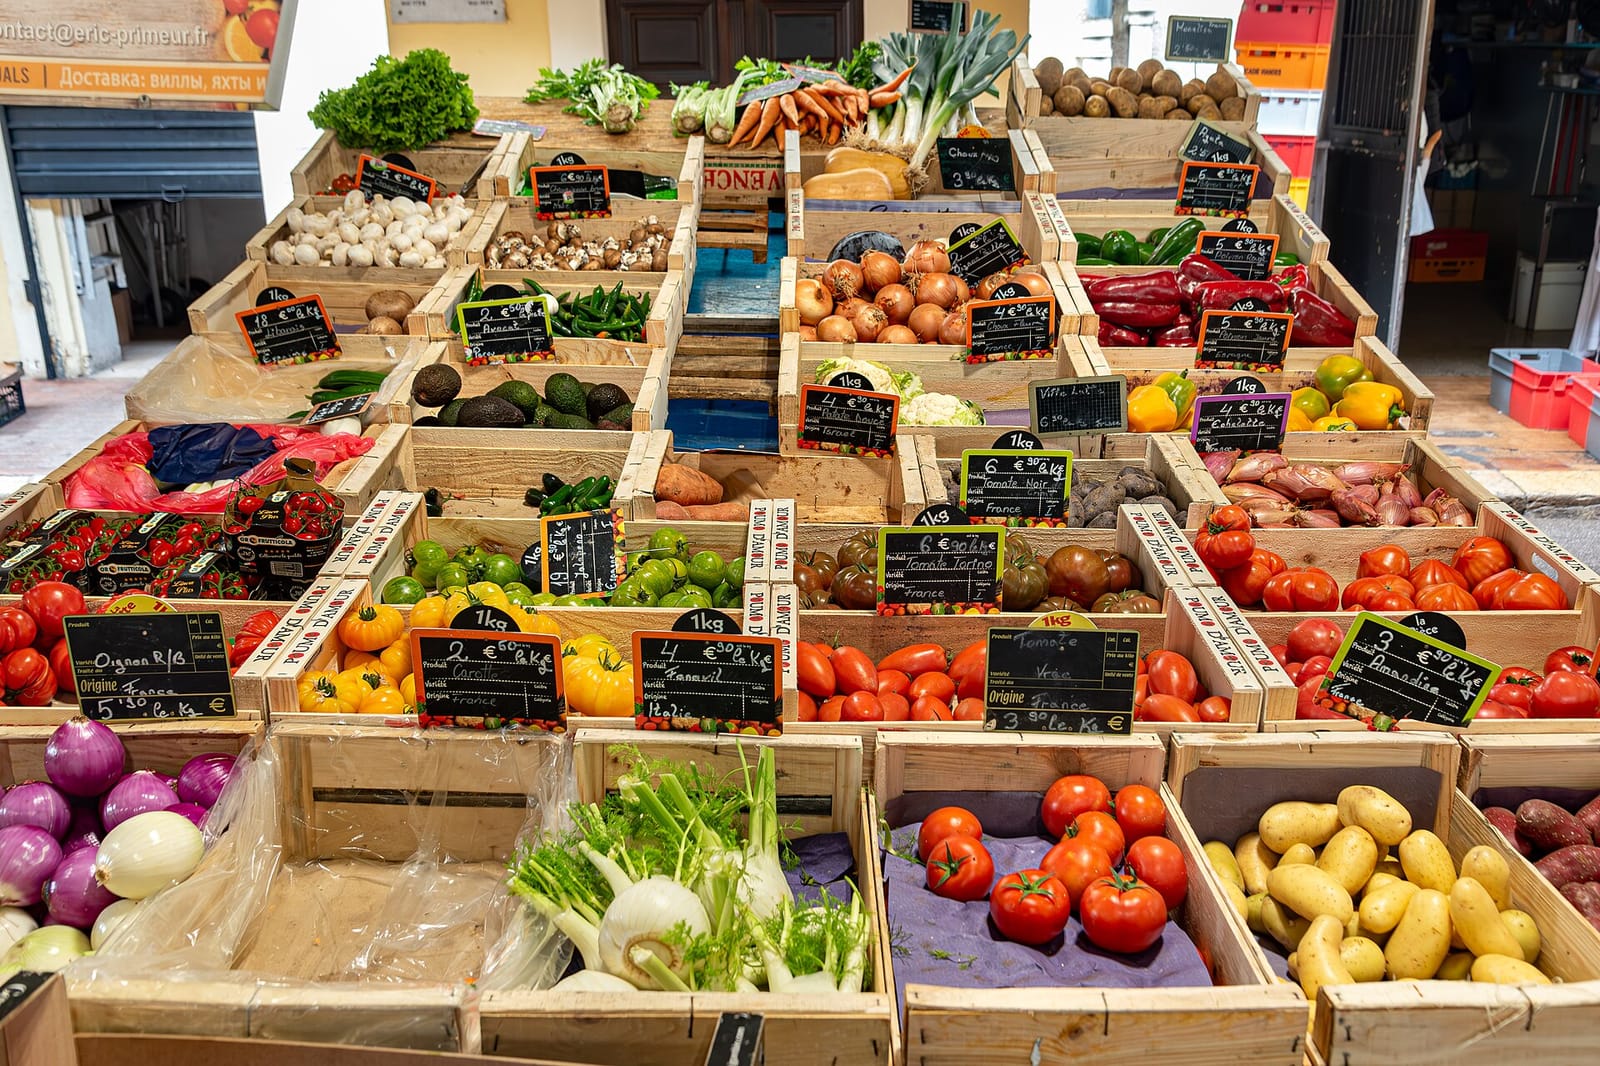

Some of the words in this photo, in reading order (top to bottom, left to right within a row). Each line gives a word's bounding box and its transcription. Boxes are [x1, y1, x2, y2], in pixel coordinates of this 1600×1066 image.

[59, 66, 145, 88] Доставка:
[150, 73, 208, 92] виллы,
[212, 75, 250, 90] яхты
[556, 156, 574, 165] 1kg
[953, 172, 963, 188] 3
[1237, 220, 1252, 234] 1kg
[1216, 238, 1226, 250] 5
[995, 287, 1015, 300] 1kg
[994, 306, 1005, 319] 4
[254, 314, 268, 328] 18
[1221, 316, 1232, 330] 5
[839, 375, 861, 388] 1kg
[1237, 379, 1257, 394] 1kg
[822, 393, 836, 407] 4
[1220, 404, 1232, 417] 4
[1010, 433, 1034, 450] 1kg
[985, 458, 999, 473] 6
[1027, 457, 1040, 466] 90
[983, 476, 1018, 488] Tomate
[1026, 479, 1048, 488] Noir
[362, 498, 390, 523] POUMO
[986, 503, 1022, 514] France
[753, 507, 766, 531] POUMO
[772, 507, 789, 540] D'AMOUR
[921, 510, 949, 526] 1kg
[358, 536, 389, 565] POUMO
[379, 501, 413, 534] D'AMOUR
[1152, 511, 1183, 544] D'AMOUR
[331, 526, 373, 564] D'AMOUR
[920, 535, 932, 553] 6
[938, 538, 950, 550] €
[951, 541, 967, 552] 90
[1130, 512, 1155, 537] POUMO
[1147, 539, 1178, 576] D'AMOUR
[1501, 510, 1538, 534] POUMO
[1534, 536, 1586, 572] D'AMOUR
[553, 552, 565, 562] €
[750, 534, 770, 568] D'AMOUR
[775, 542, 788, 570] POUMO
[906, 554, 948, 569] Tomate
[954, 556, 993, 569] Torino
[1175, 545, 1203, 574] POUMO
[550, 572, 569, 587] 19
[295, 585, 331, 614] POUMO
[905, 586, 945, 597] France
[749, 592, 764, 622] POUMO
[772, 594, 791, 634] D'AMOUR
[476, 610, 508, 632] 1kg
[691, 612, 724, 633] 1kg
[1042, 615, 1072, 627] 1kg
[1212, 595, 1251, 636] D'AMOUR
[1415, 615, 1426, 626] la
[283, 631, 321, 664] POUMO
[311, 588, 356, 627] D'AMOUR
[253, 617, 305, 662] D'AMOUR
[1014, 632, 1078, 648] Tomate
[1185, 596, 1216, 627] POUMO
[1206, 630, 1247, 676] D'AMOUR
[661, 640, 678, 662] 4
[703, 646, 717, 660] €
[717, 642, 734, 652] 90
[1242, 638, 1279, 672] POUMO
[1352, 642, 1376, 656] Produit
[95, 653, 149, 674] Oignon
[153, 649, 186, 673] R/B
[423, 661, 447, 669] Produit
[483, 646, 497, 659] €
[530, 650, 552, 675] Kg
[1373, 630, 1394, 651] 3
[1416, 650, 1433, 665] €
[1433, 650, 1451, 662] 90
[1473, 678, 1483, 687] €
[1342, 661, 1364, 674] Variété
[425, 680, 447, 688] Variété
[643, 681, 665, 689] Variété
[1337, 672, 1359, 685] Origine
[80, 680, 118, 693] Origine
[121, 678, 177, 696] France
[209, 698, 226, 713] €
[452, 693, 497, 706] France
[989, 690, 1024, 705] Origine
[1031, 692, 1090, 711] France
[649, 702, 692, 718] Italie
[1003, 712, 1018, 730] 3
[1028, 712, 1047, 721] 90
[1107, 716, 1125, 731] €
